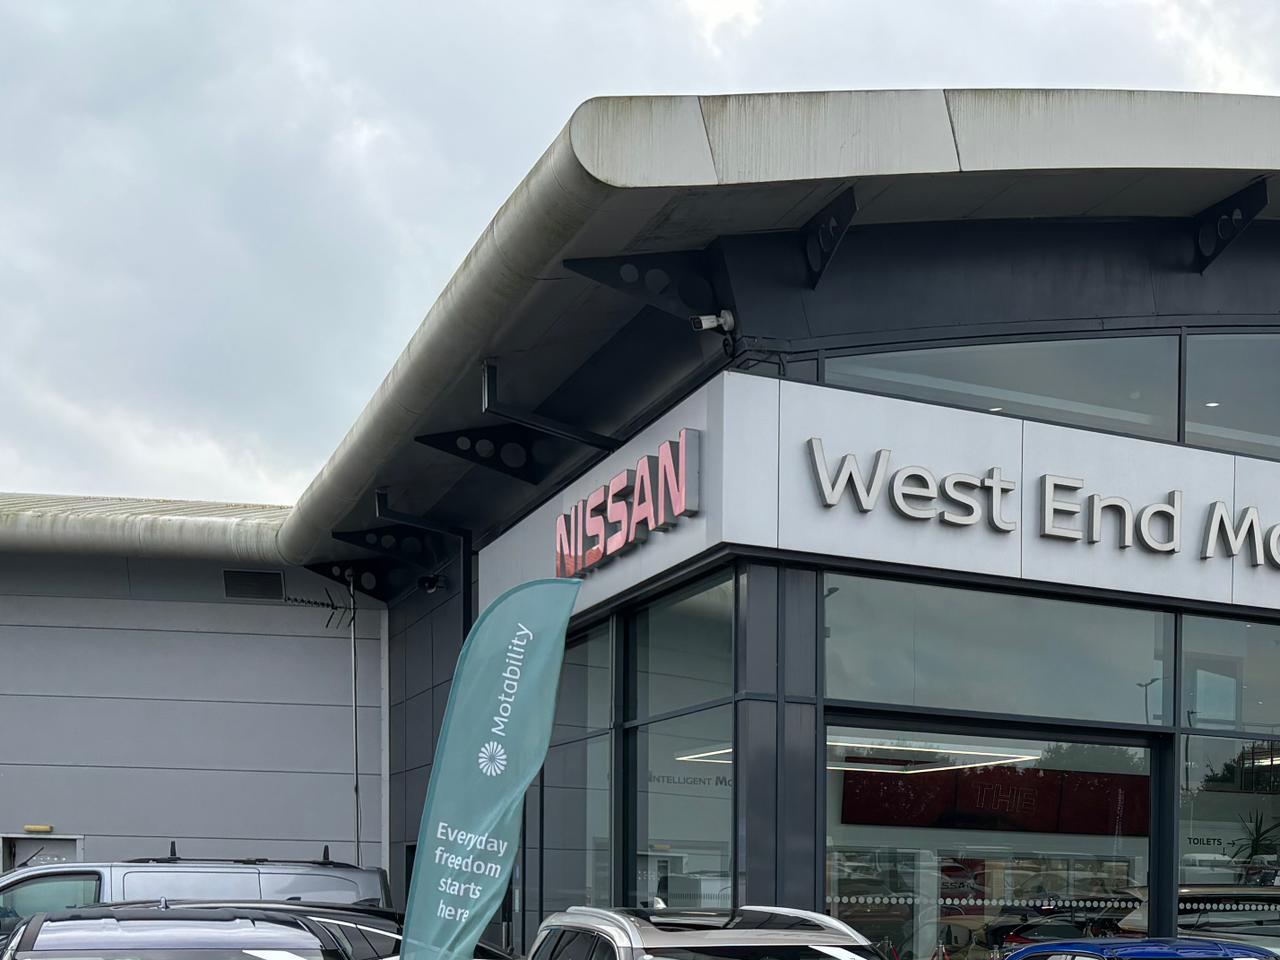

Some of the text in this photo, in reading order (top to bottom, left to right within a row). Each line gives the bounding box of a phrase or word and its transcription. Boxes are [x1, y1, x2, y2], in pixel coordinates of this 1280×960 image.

[556, 428, 701, 578] NISSAN
[808, 438, 1017, 534] West
[1040, 471, 1184, 556] End
[491, 622, 535, 737] Motability
[649, 775, 712, 786] INTELLIGENT
[437, 822, 508, 856] Everyday
[1187, 837, 1223, 847] TOILETS
[434, 846, 501, 878] freedom
[438, 874, 483, 900] starts
[437, 899, 469, 922] here
